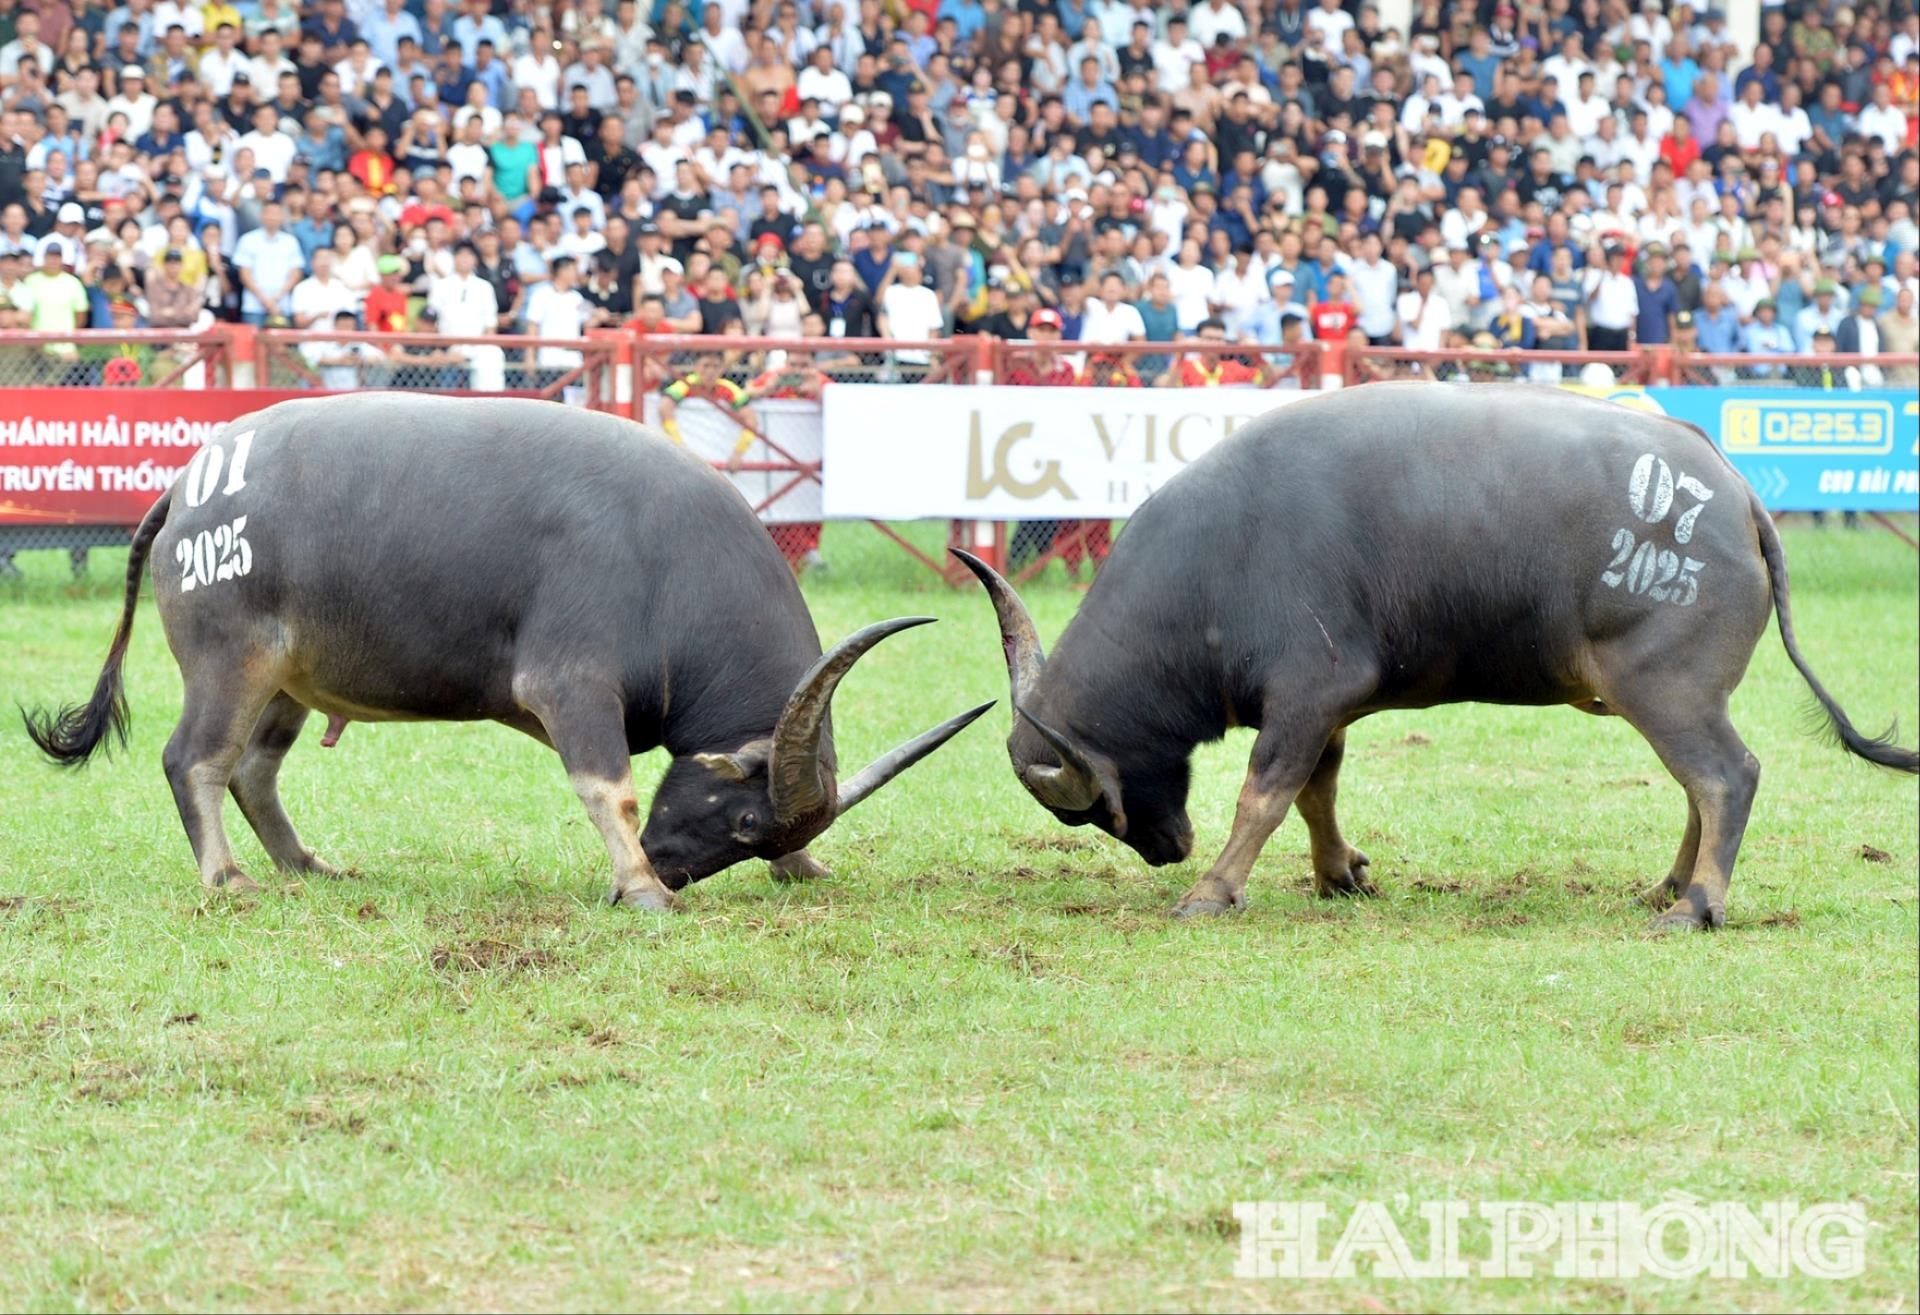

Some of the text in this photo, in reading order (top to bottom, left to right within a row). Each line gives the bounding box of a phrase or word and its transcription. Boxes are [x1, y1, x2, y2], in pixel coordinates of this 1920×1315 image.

[81, 414, 130, 447] HẢI
[1765, 412, 1883, 442] 0225.3
[185, 429, 256, 508] 01
[1629, 453, 1714, 544] 07
[176, 515, 253, 593] 2025
[1601, 528, 1706, 606] 2025
